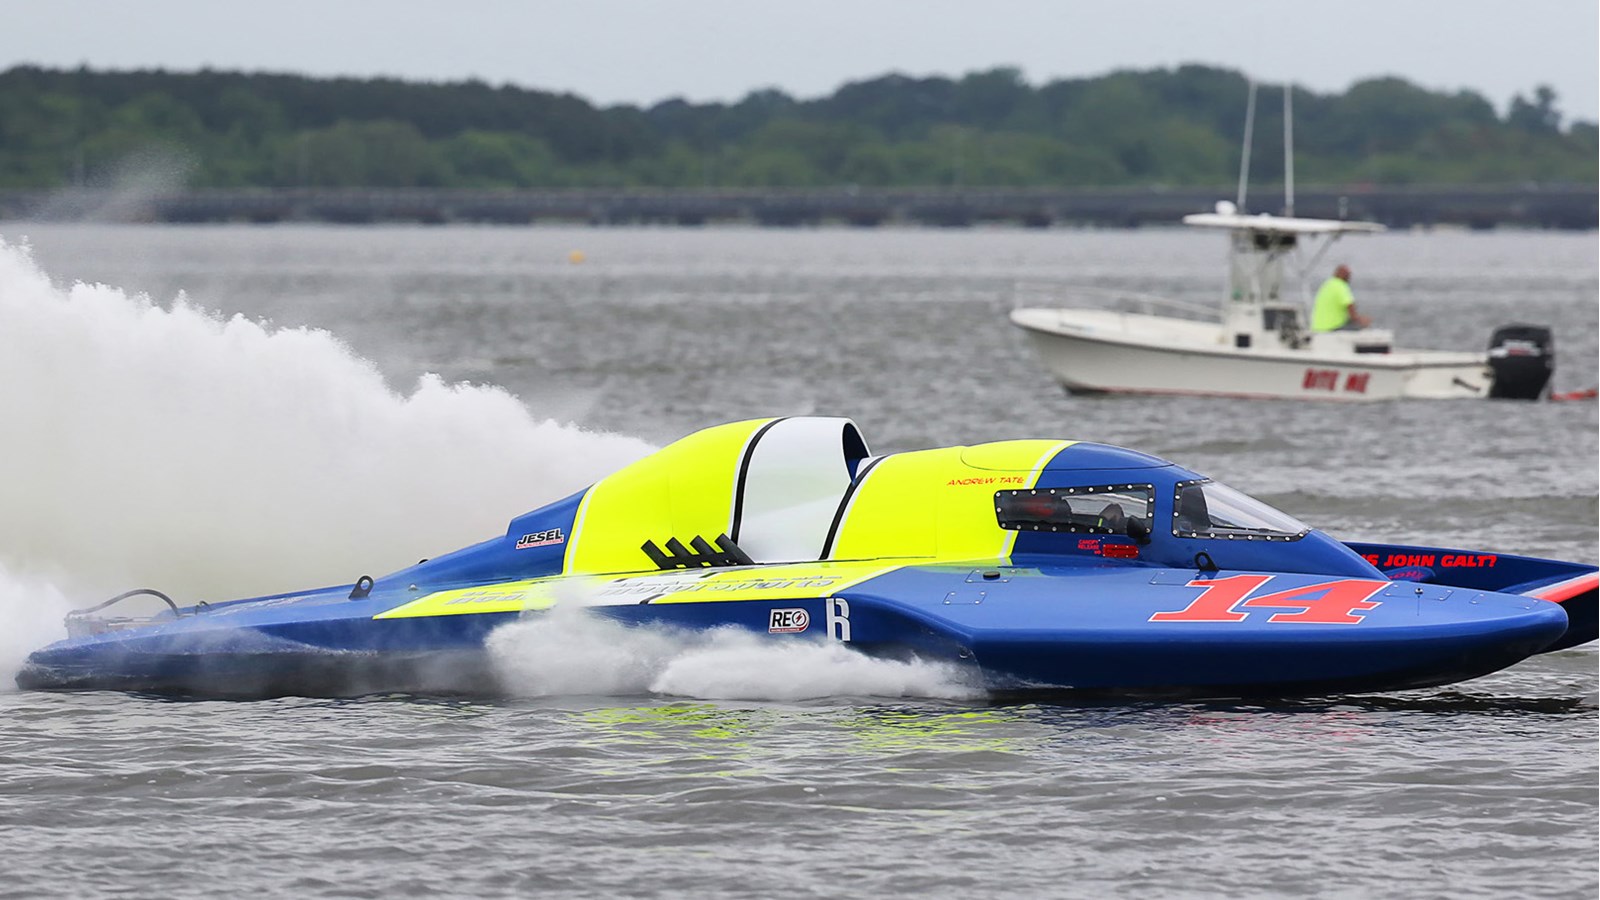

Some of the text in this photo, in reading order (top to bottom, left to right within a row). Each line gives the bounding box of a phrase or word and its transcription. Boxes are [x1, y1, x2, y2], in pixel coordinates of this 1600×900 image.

[946, 476, 1024, 486] ANDREW TATE
[517, 528, 563, 545] JESEL
[1383, 554, 1436, 567] JOHN
[1440, 554, 1497, 568] GALT?
[1148, 574, 1393, 625] 14
